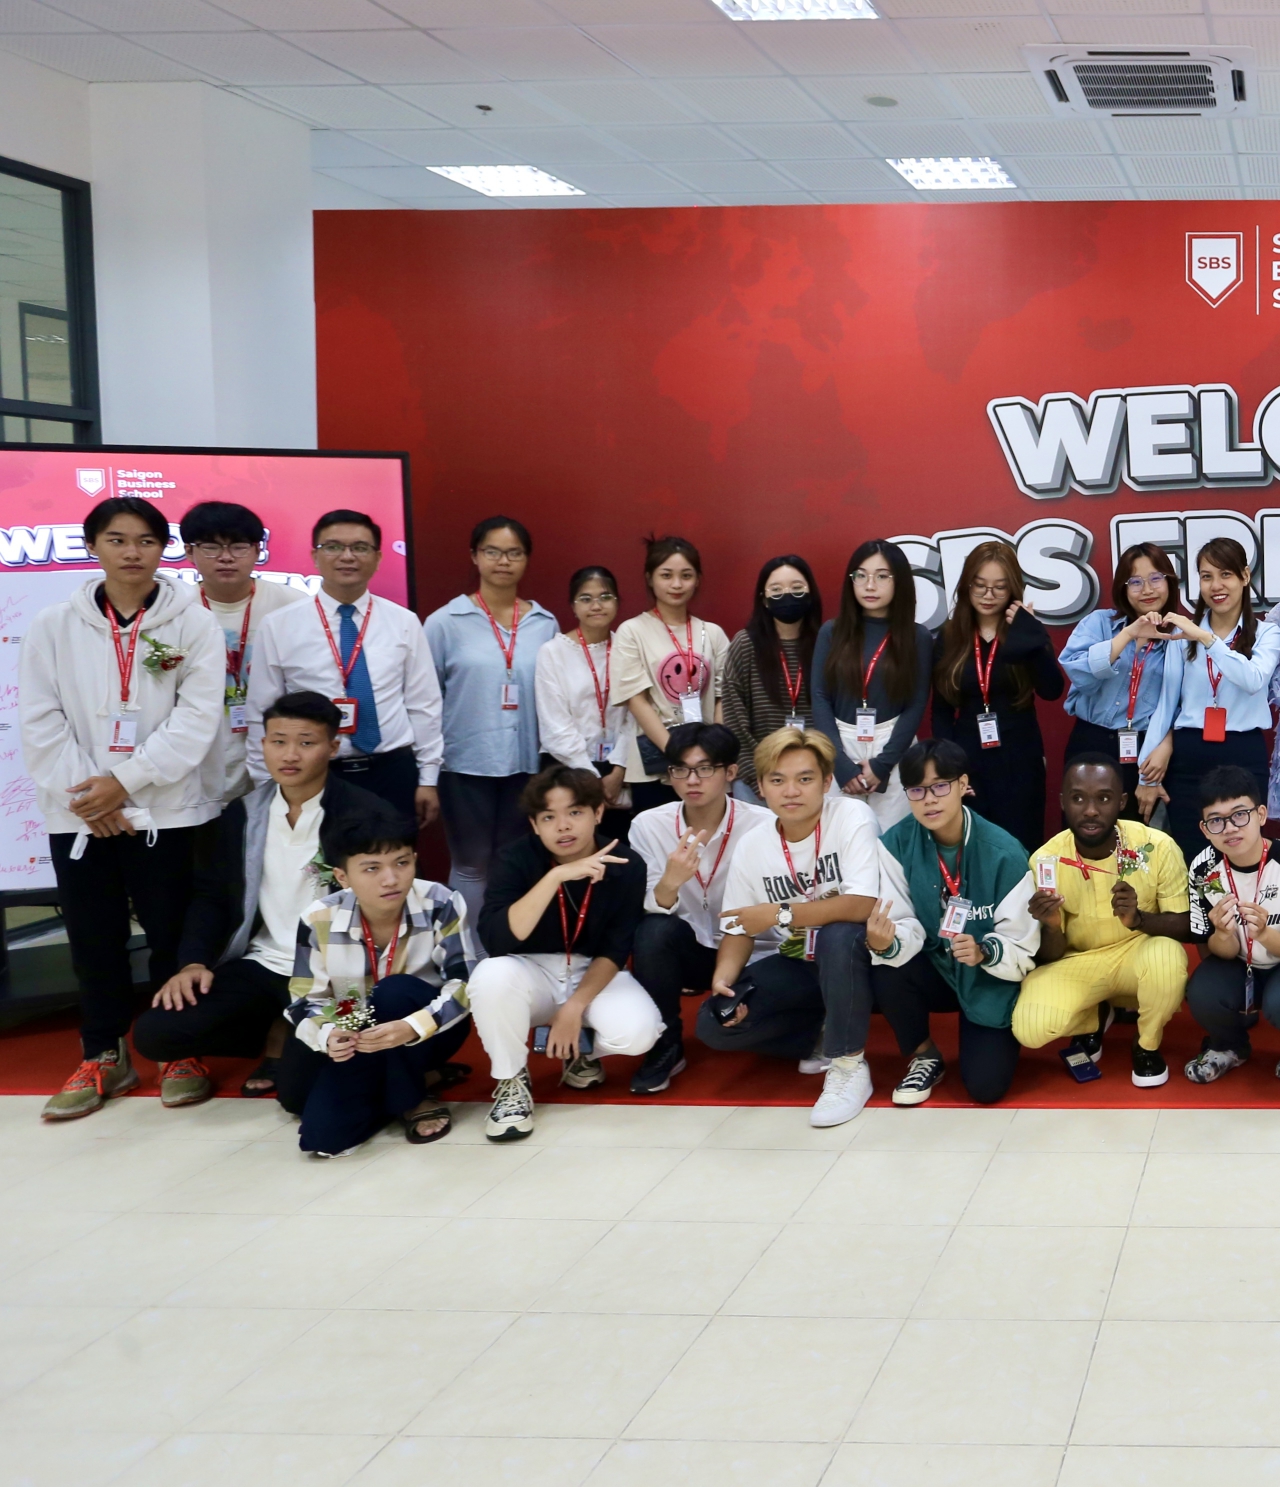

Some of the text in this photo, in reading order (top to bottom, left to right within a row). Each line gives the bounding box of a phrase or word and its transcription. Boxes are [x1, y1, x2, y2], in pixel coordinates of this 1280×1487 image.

[1197, 256, 1232, 270] SBS
[116, 469, 163, 479] Saigon
[117, 480, 176, 489] Business
[118, 489, 164, 498] School
